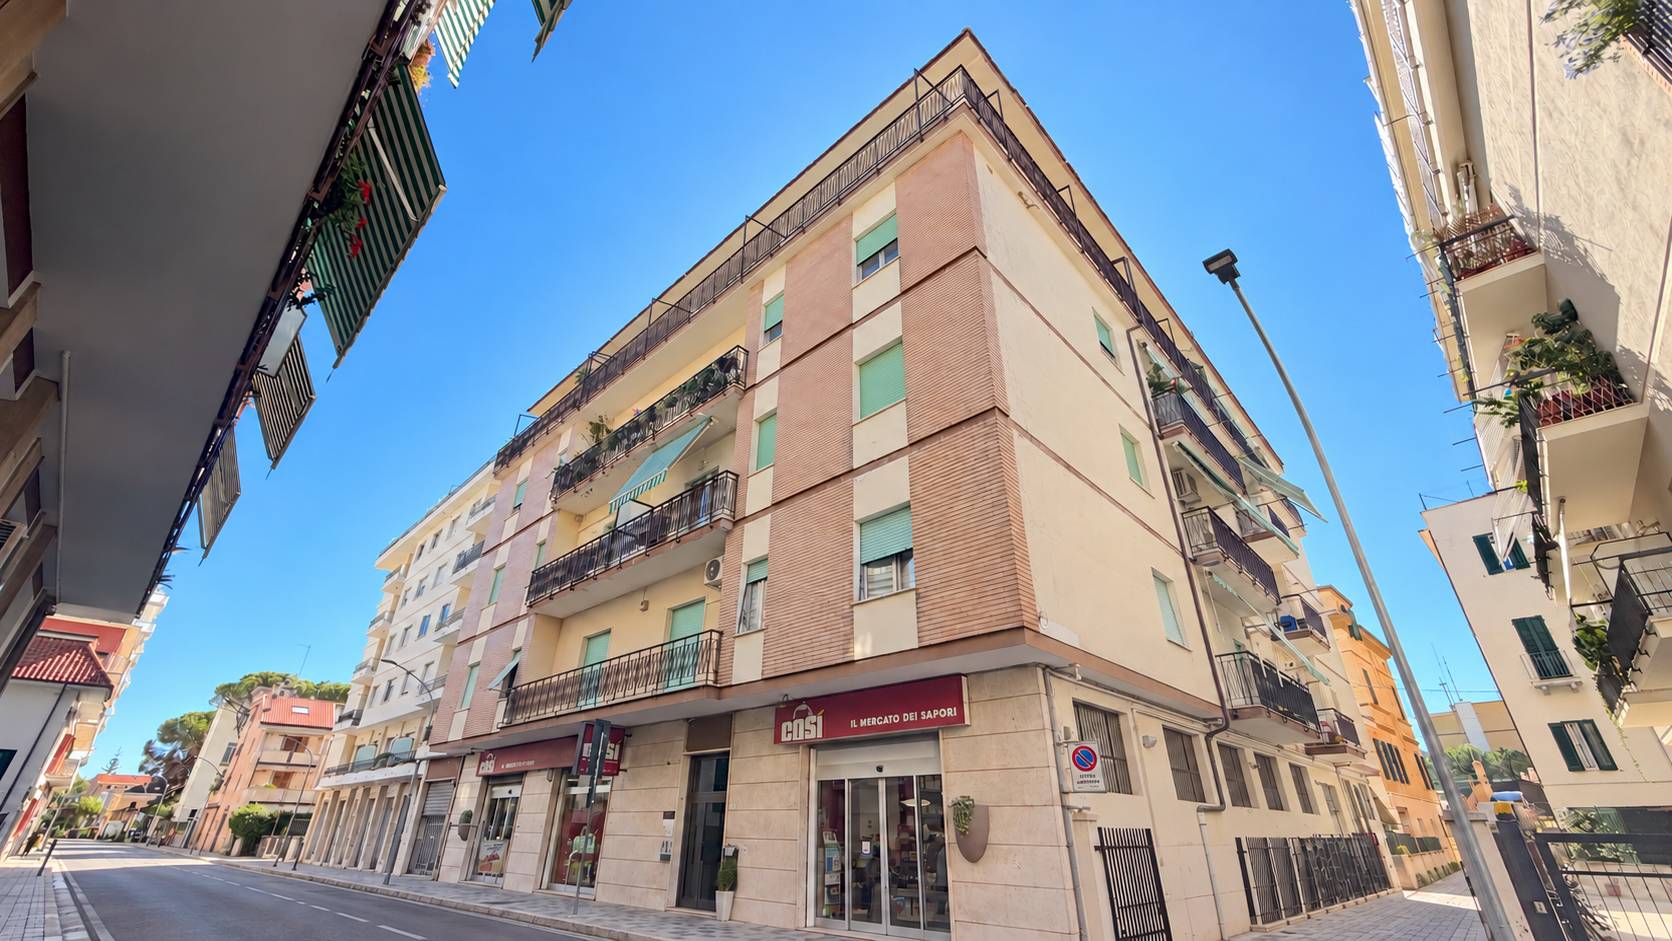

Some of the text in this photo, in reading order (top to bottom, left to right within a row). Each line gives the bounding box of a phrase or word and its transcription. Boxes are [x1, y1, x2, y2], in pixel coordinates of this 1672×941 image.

[850, 707, 957, 728] IL MERCATO DEI SAPORI
